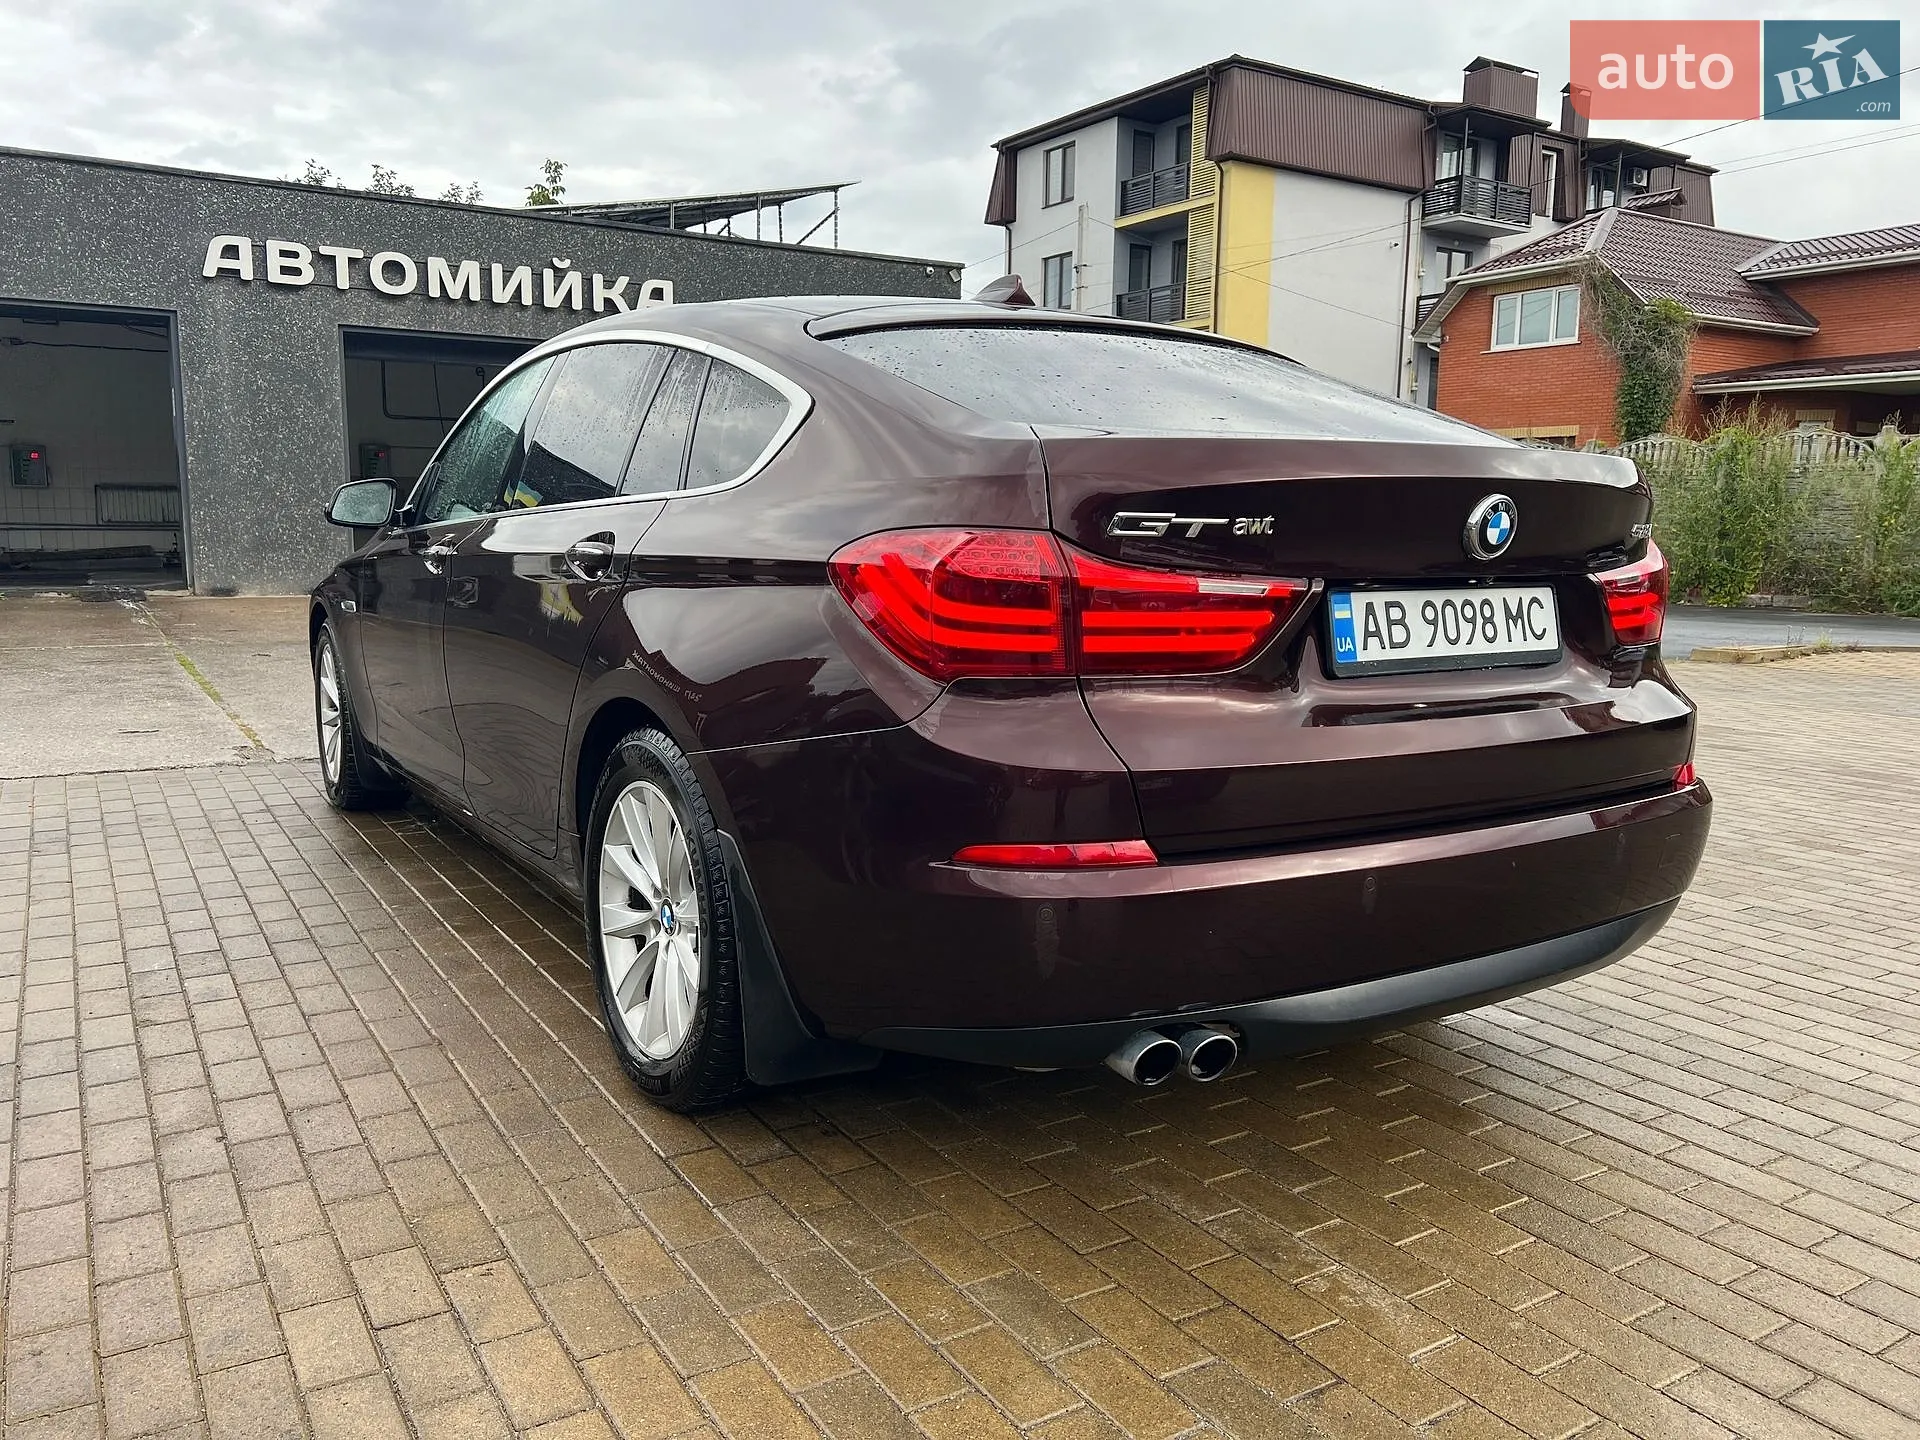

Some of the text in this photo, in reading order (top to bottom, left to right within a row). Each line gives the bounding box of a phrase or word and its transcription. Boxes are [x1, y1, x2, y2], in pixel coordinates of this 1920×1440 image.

[202, 234, 675, 312] АВТОМИЙКА
[1107, 511, 1230, 538] GT
[1362, 596, 1548, 651] AB 9098 MC
[1336, 637, 1355, 653] UA
